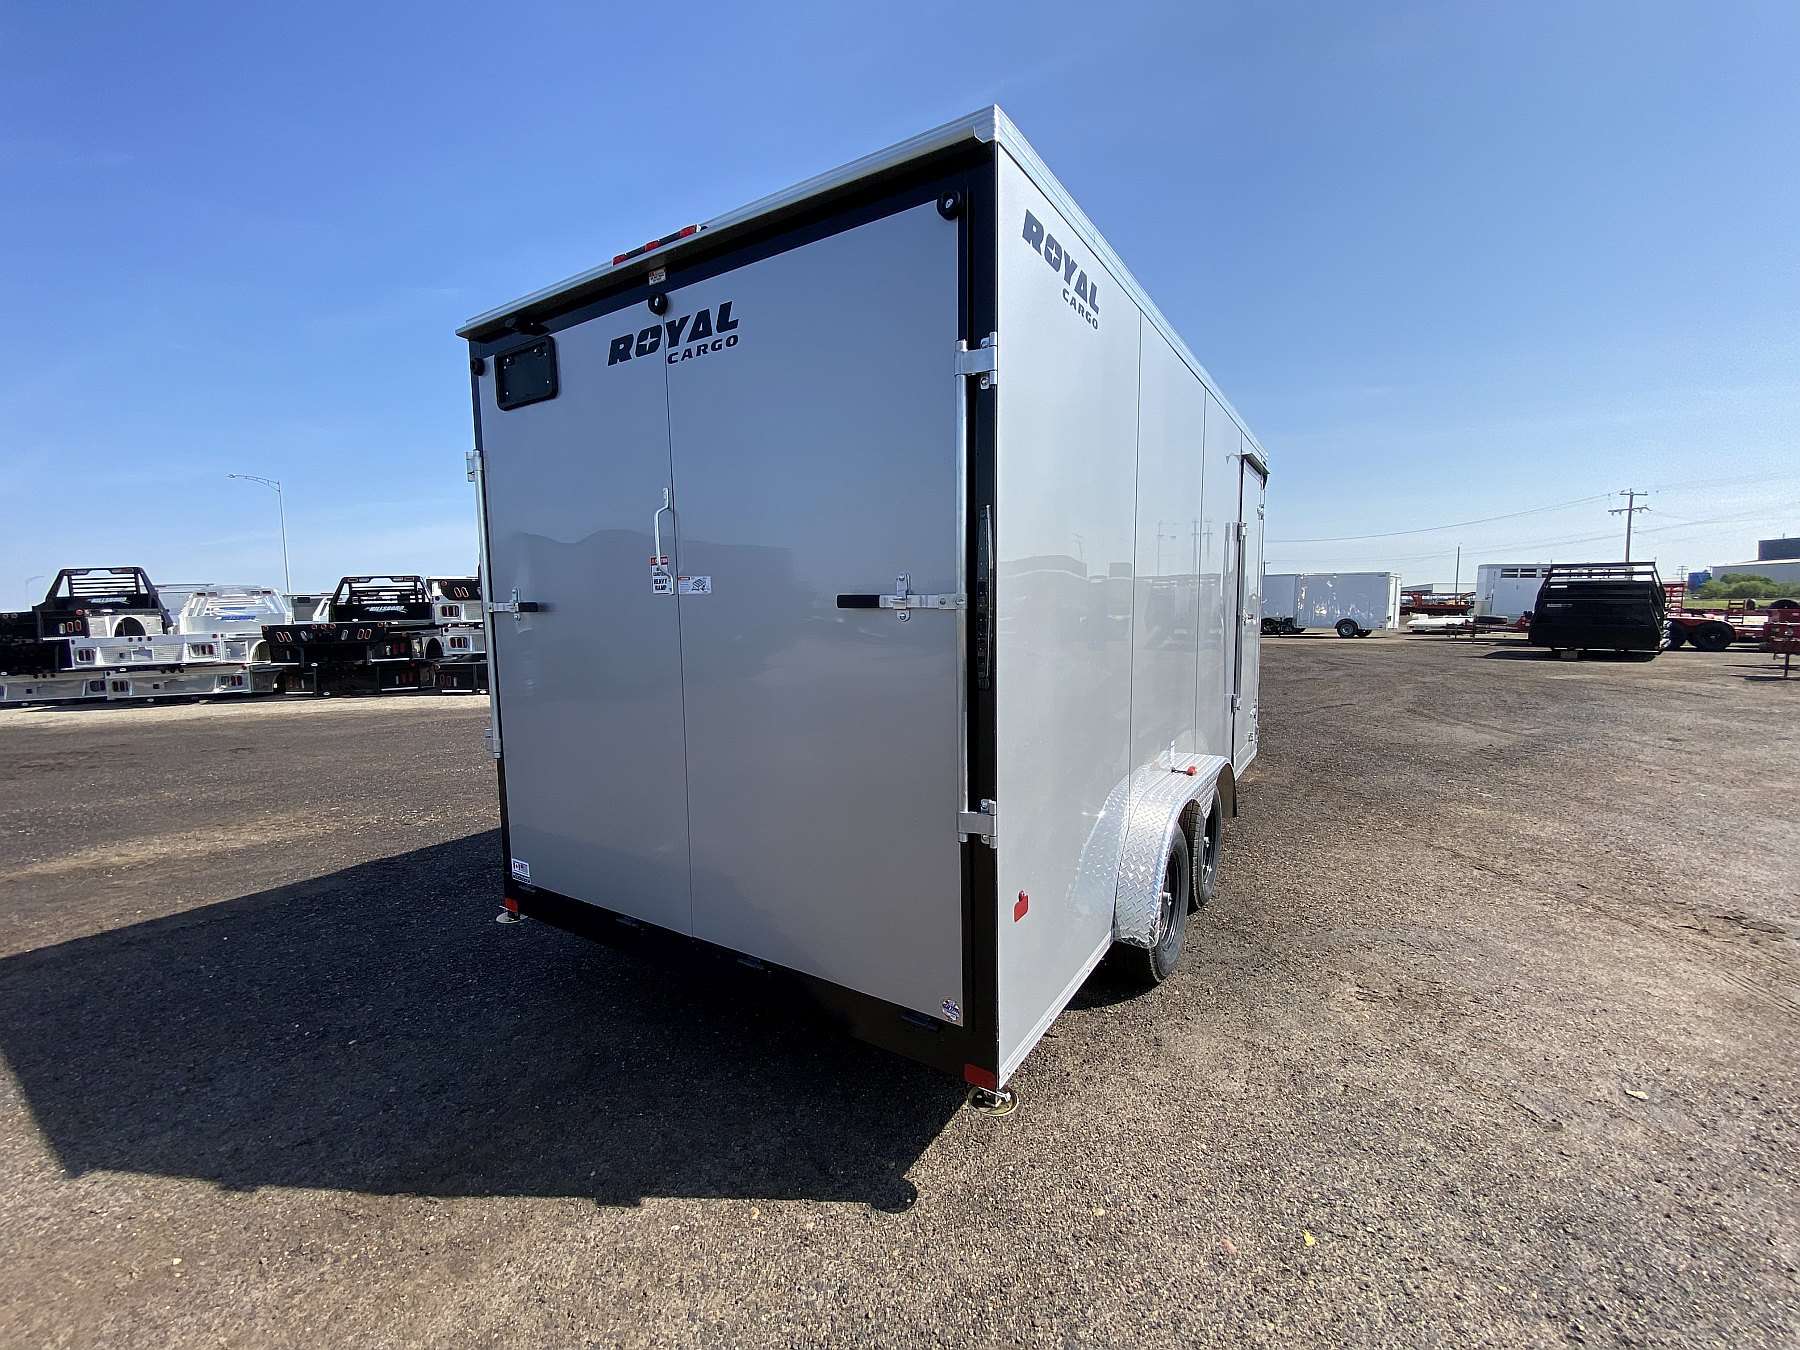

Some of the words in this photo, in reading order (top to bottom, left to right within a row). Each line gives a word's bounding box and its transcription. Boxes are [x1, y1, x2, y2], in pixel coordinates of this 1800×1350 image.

[1022, 209, 1099, 315] ROYAL
[607, 301, 739, 366] ROYAL
[1062, 288, 1098, 330] CARGO
[667, 334, 739, 365] CARGO
